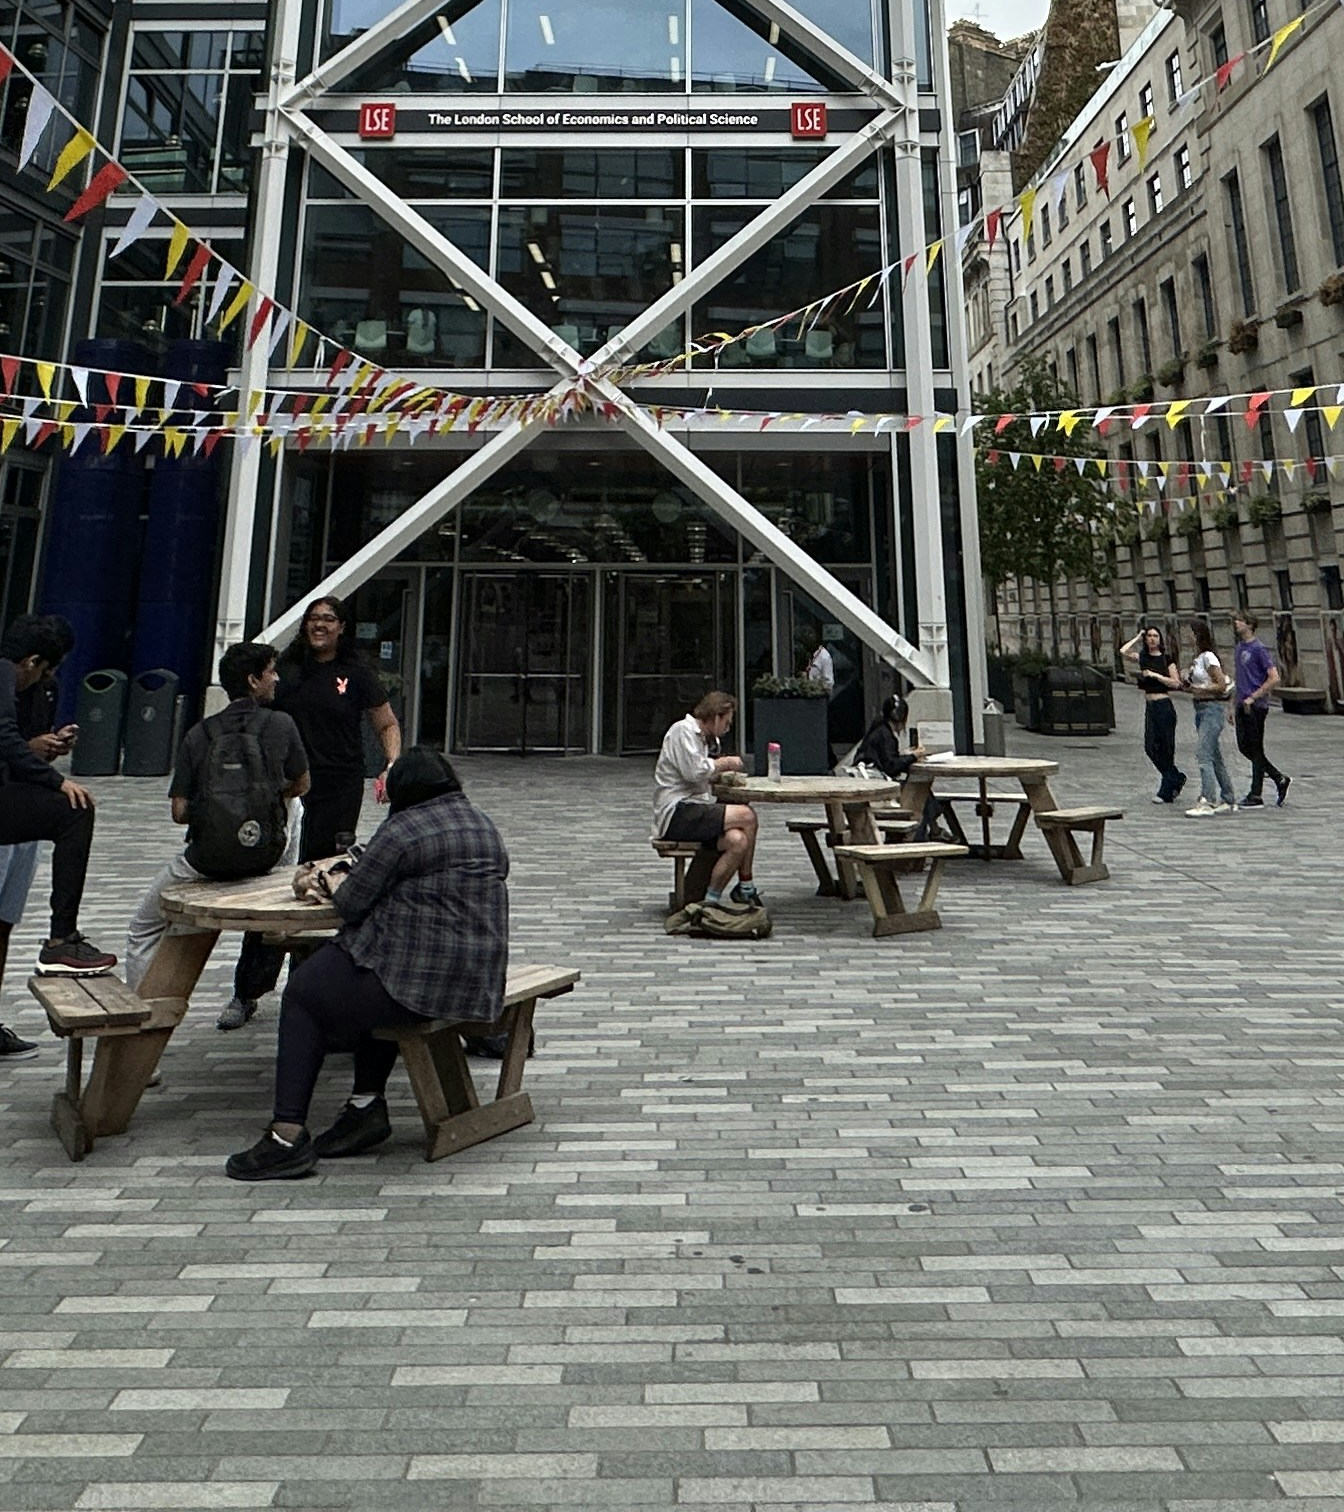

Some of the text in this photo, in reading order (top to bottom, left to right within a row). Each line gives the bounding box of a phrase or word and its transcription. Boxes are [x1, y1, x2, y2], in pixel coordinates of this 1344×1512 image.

[365, 108, 389, 131] LSE
[428, 112, 758, 125] The London School of Economics and Political Science
[797, 108, 821, 131] LSE
